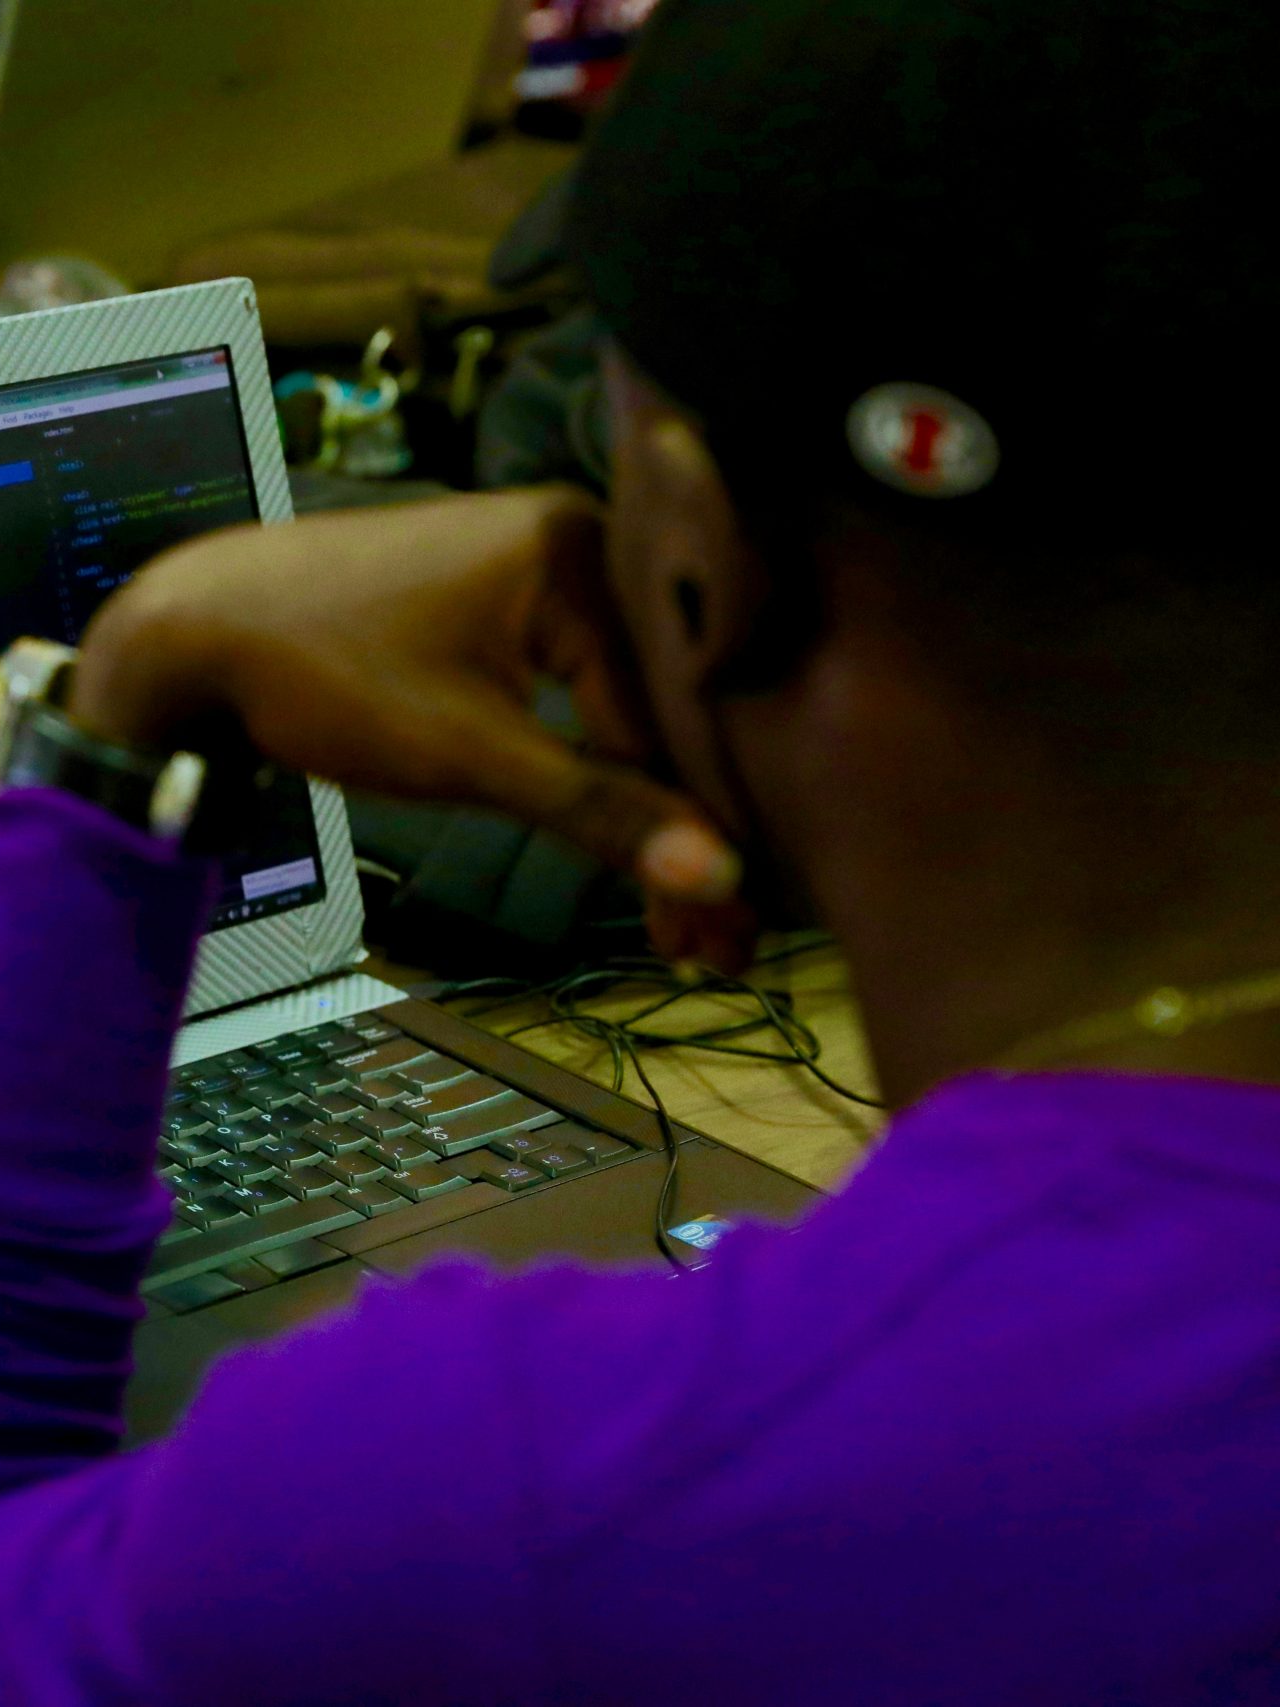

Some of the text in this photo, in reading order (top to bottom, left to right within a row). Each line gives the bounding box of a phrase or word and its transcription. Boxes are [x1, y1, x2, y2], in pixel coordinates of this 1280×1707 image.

[393, 1170, 411, 1179] Ctrl
[234, 1187, 253, 1198] M
[185, 1203, 204, 1213] N
